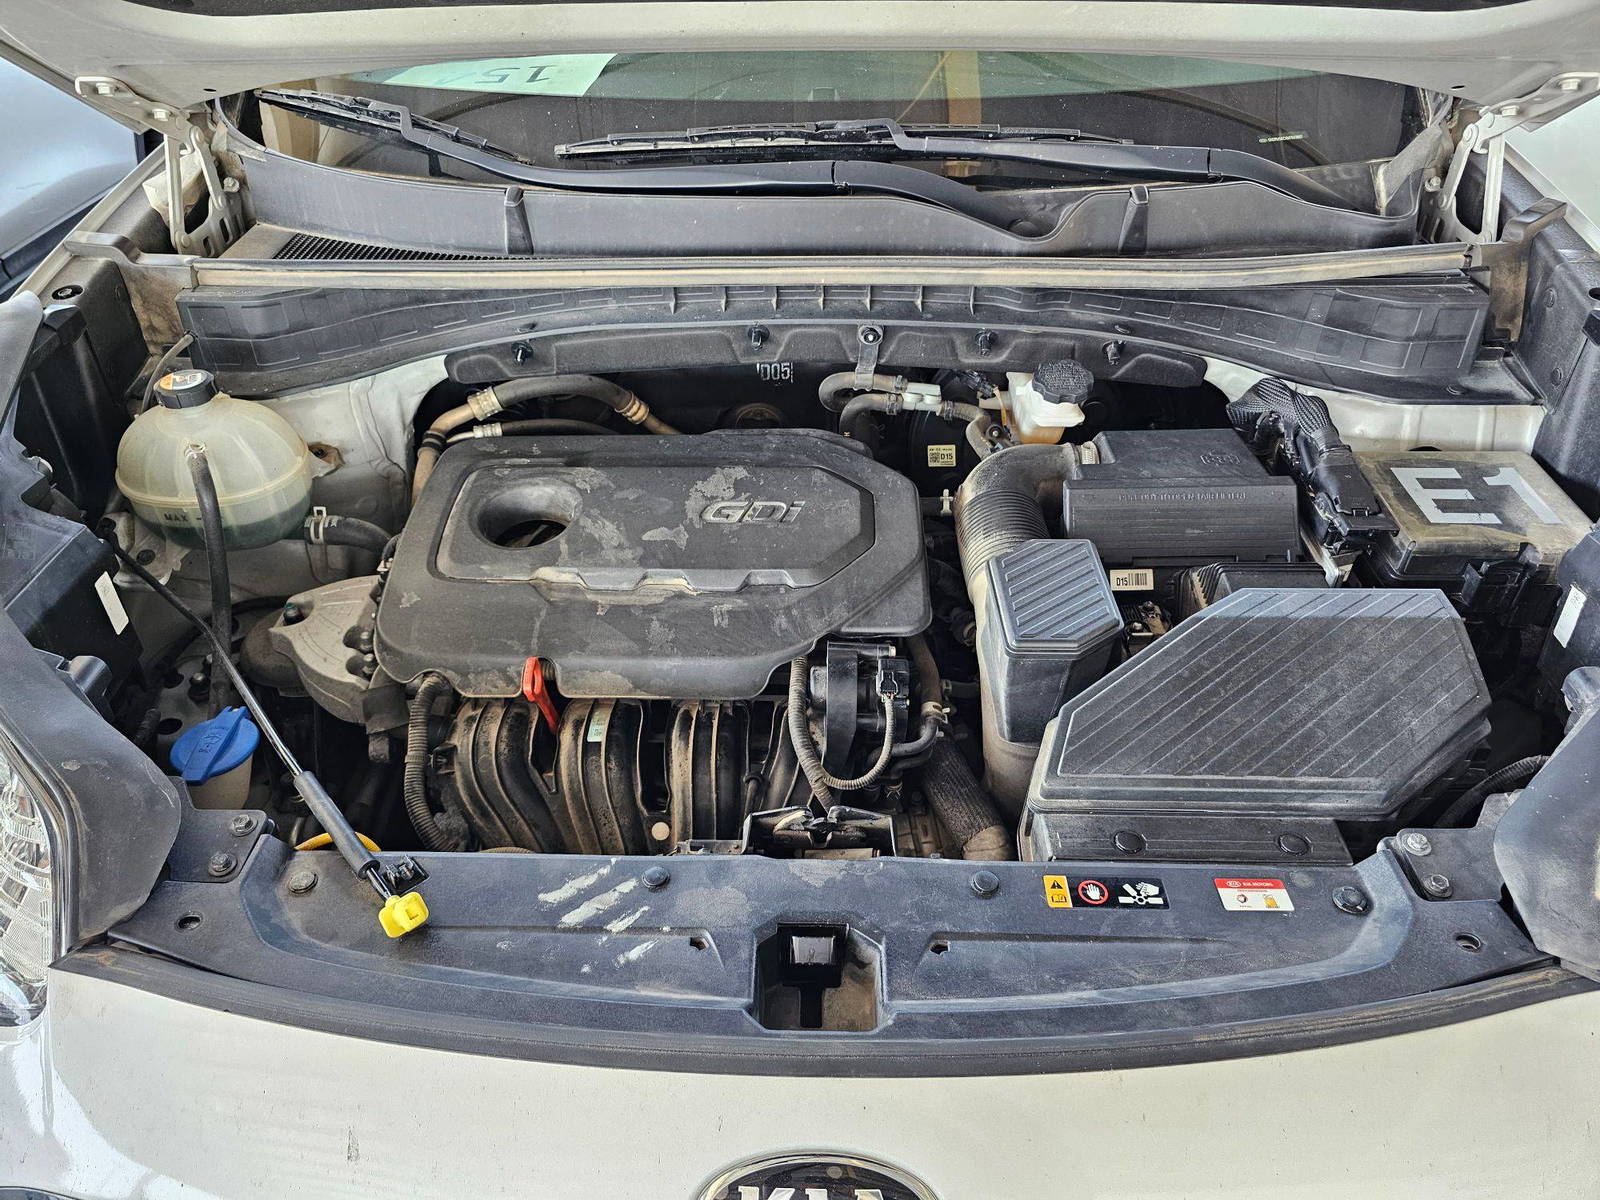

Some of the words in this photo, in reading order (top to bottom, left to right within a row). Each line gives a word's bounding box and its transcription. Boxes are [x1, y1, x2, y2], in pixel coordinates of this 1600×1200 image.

[940, 453, 954, 461] D15
[1390, 467, 1564, 525] E1
[700, 501, 805, 523] GDi
[164, 513, 188, 522] MAX
[1116, 577, 1128, 586] D15
